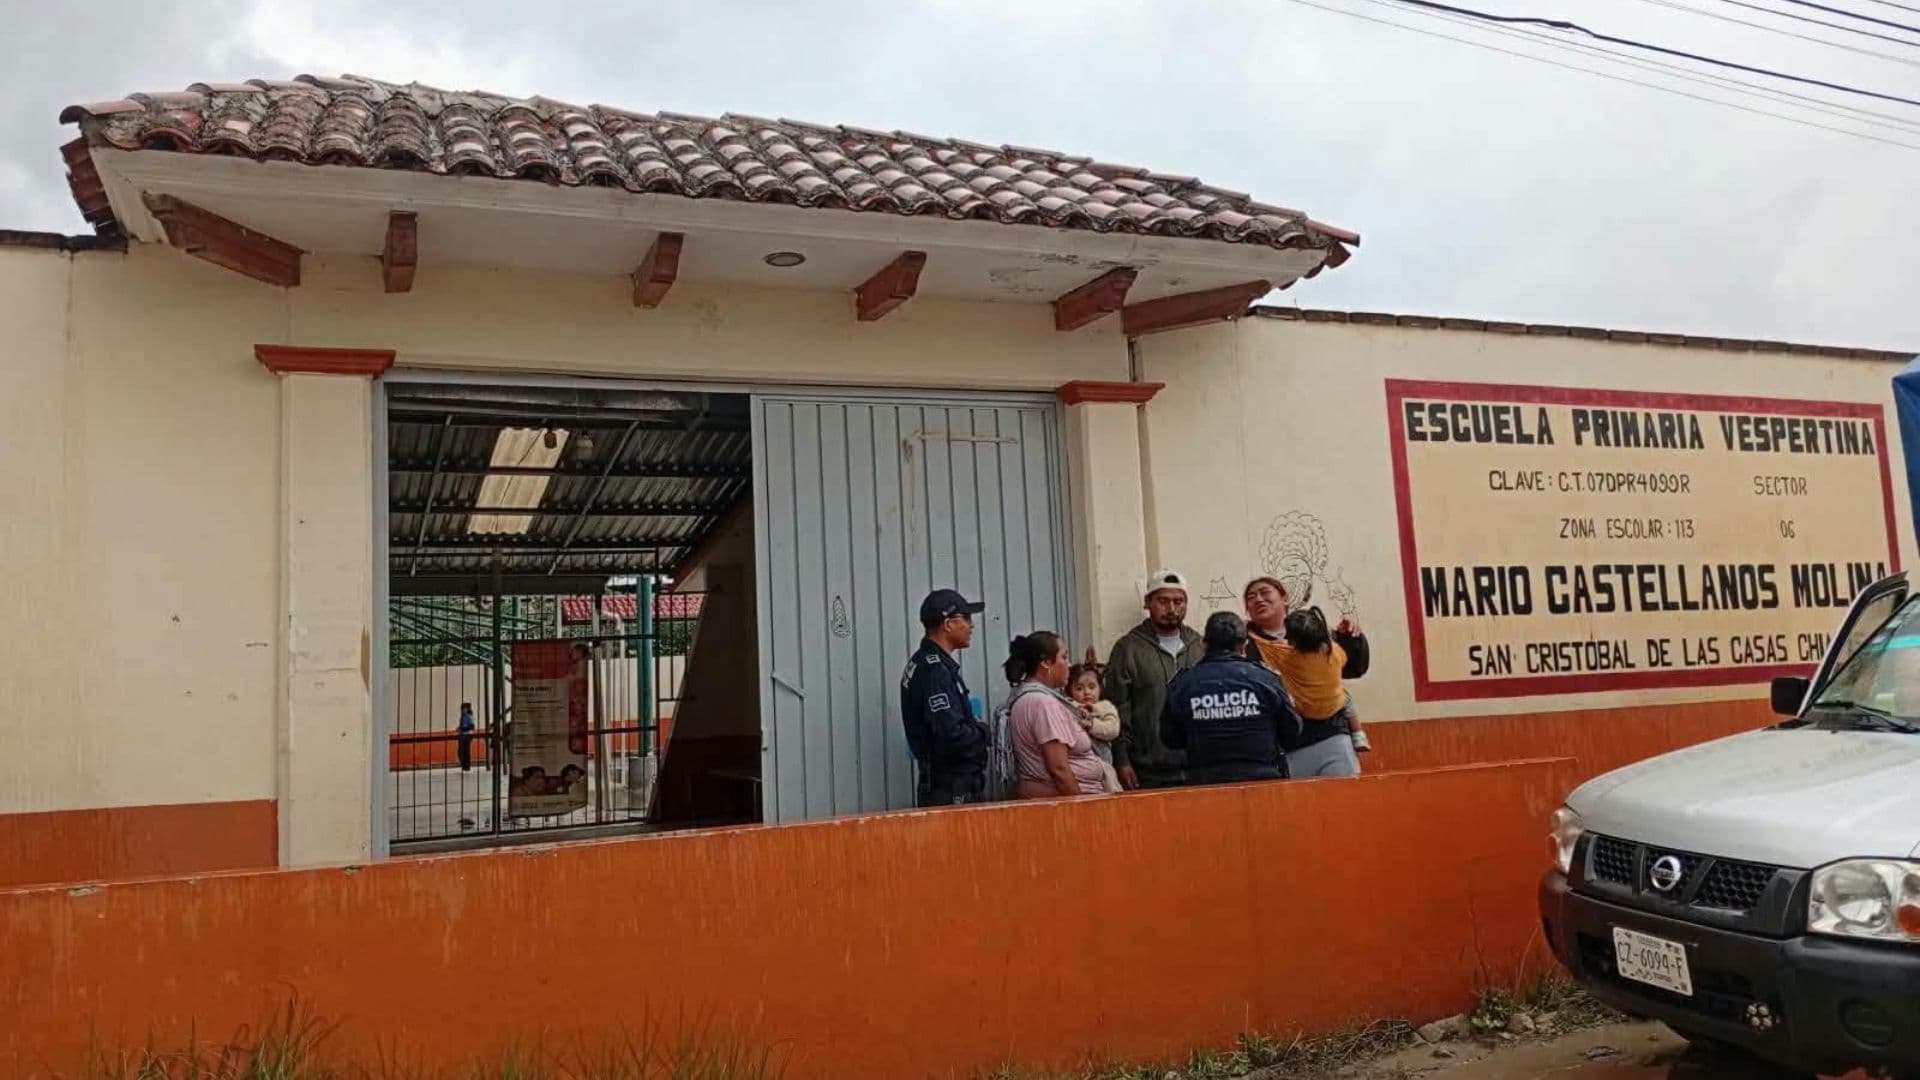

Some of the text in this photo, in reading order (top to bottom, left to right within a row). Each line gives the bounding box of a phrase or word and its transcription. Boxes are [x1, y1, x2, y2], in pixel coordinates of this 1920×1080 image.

[1404, 402, 1875, 455] ESCUELA PRIMARIA VESPERTINA
[1753, 476, 1808, 496] SECTOR
[1559, 518, 1596, 539] ZONA
[1780, 519, 1795, 539] 06
[1420, 566, 1534, 617] MARIO
[1545, 564, 1779, 614] CASTELLANOS
[1469, 644, 1512, 676] SAN
[1647, 638, 1672, 668] DE
[1683, 636, 1721, 666] LAS
[1730, 634, 1789, 664] CASAS
[1190, 689, 1259, 709] POLICÍA
[1192, 705, 1261, 720] MUNICIPAL
